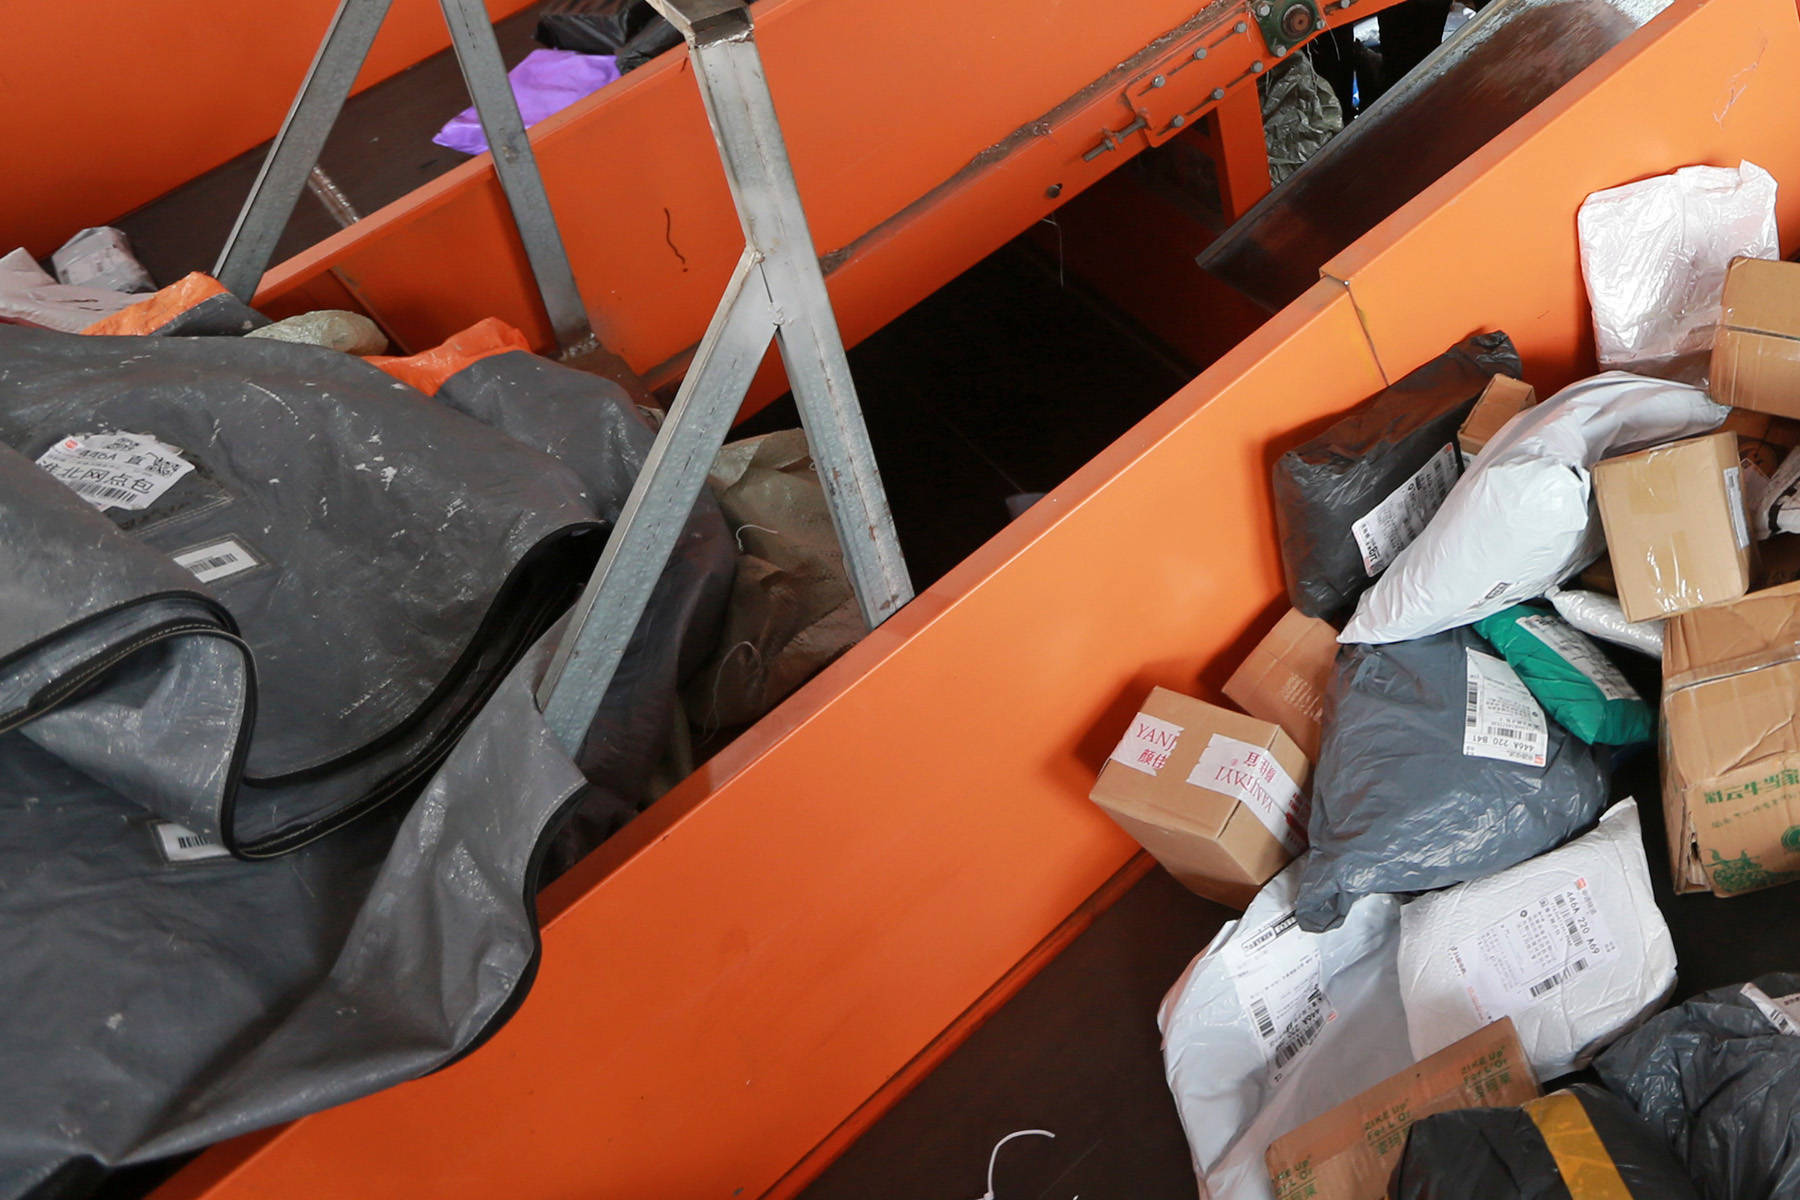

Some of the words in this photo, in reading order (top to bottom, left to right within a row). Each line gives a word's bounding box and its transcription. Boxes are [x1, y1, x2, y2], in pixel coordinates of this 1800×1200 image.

[1492, 736, 1510, 748] 220
[1567, 891, 1580, 914] 446A
[1577, 916, 1591, 935] 220
[1586, 937, 1601, 955] A69
